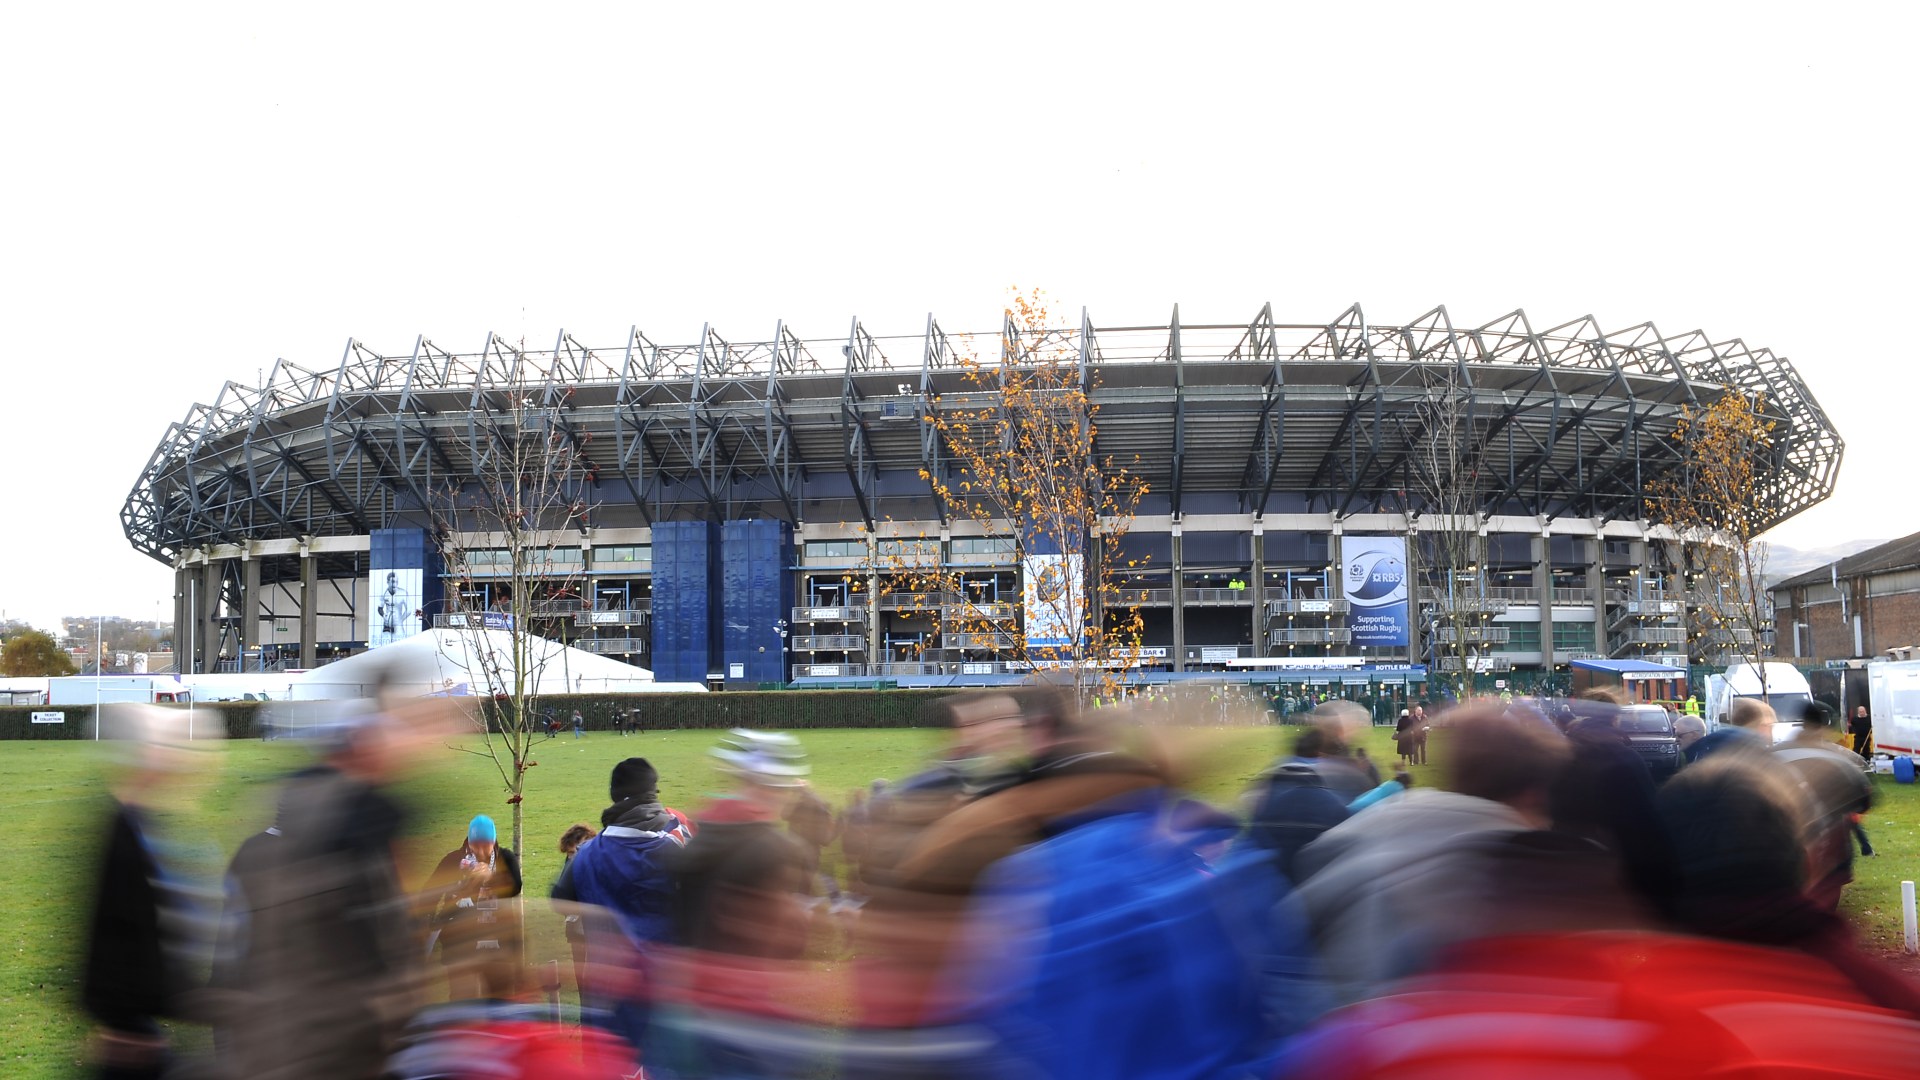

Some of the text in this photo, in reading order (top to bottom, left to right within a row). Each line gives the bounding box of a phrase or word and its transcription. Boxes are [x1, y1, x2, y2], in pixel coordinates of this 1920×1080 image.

[1382, 573, 1400, 583] RBS
[1357, 615, 1395, 624] Supporting
[1351, 624, 1402, 634] Scottish Rugby
